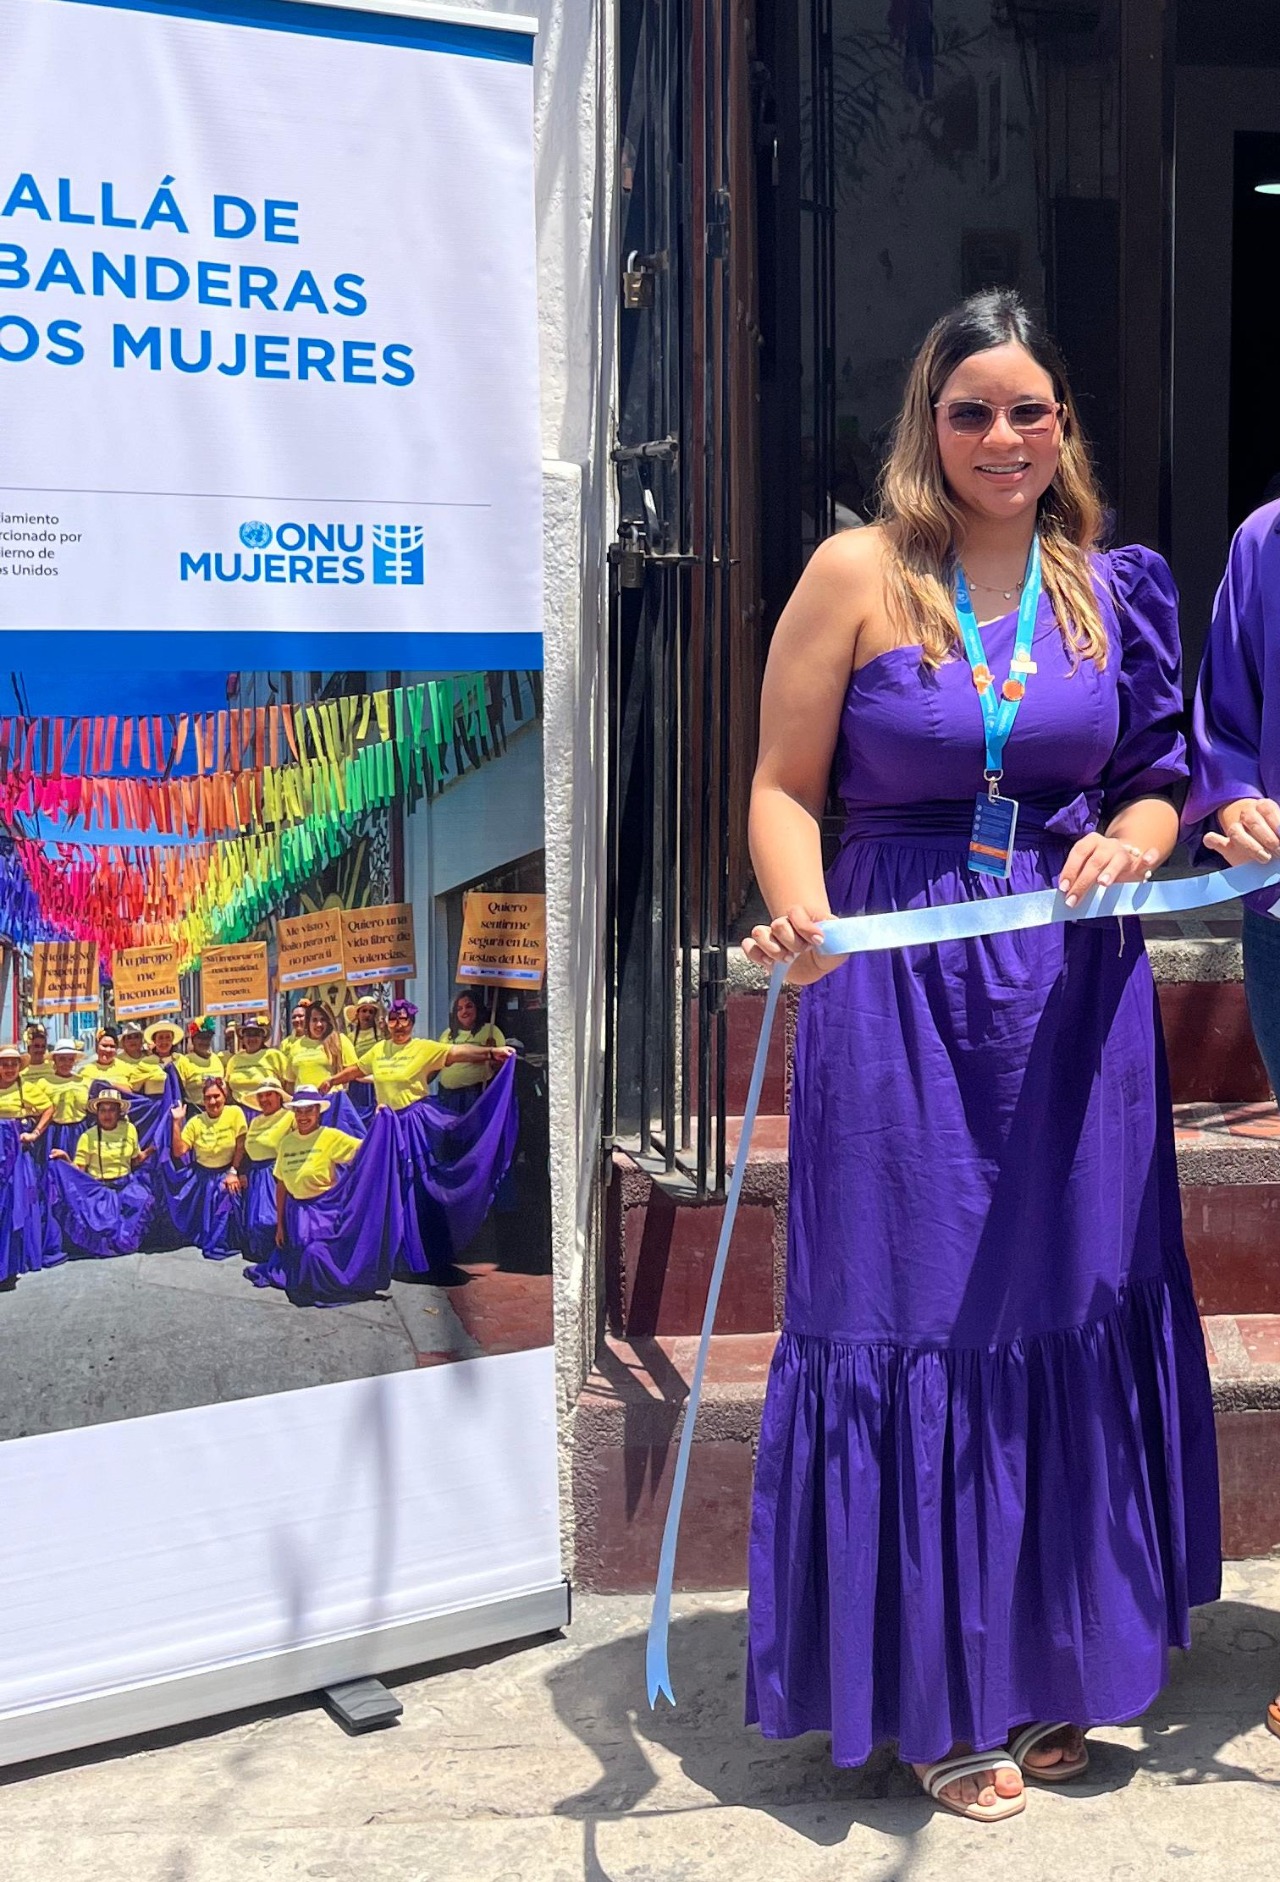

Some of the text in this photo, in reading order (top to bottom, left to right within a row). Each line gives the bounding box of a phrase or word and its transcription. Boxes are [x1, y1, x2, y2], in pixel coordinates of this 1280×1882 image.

[1, 172, 300, 244] ALLÁ DE
[0, 243, 368, 317] BANDERAS
[112, 323, 415, 387] MUJERES
[60, 532, 82, 544] por
[276, 522, 364, 552] ONU
[38, 547, 55, 559] de
[12, 564, 59, 576] Unidos
[180, 552, 365, 584] MUJERES
[487, 901, 527, 914] Quiero
[347, 916, 407, 933] Quiero una
[481, 918, 530, 930] sentirme
[303, 937, 322, 949] para
[347, 932, 411, 948] vida libre de
[467, 935, 540, 948] segura en las
[118, 951, 173, 967] Tu piropo
[289, 956, 301, 966] no
[302, 952, 324, 965] para
[462, 951, 541, 966] Fiestas del Mar
[136, 973, 156, 982] me
[119, 984, 176, 1000] incomoda
